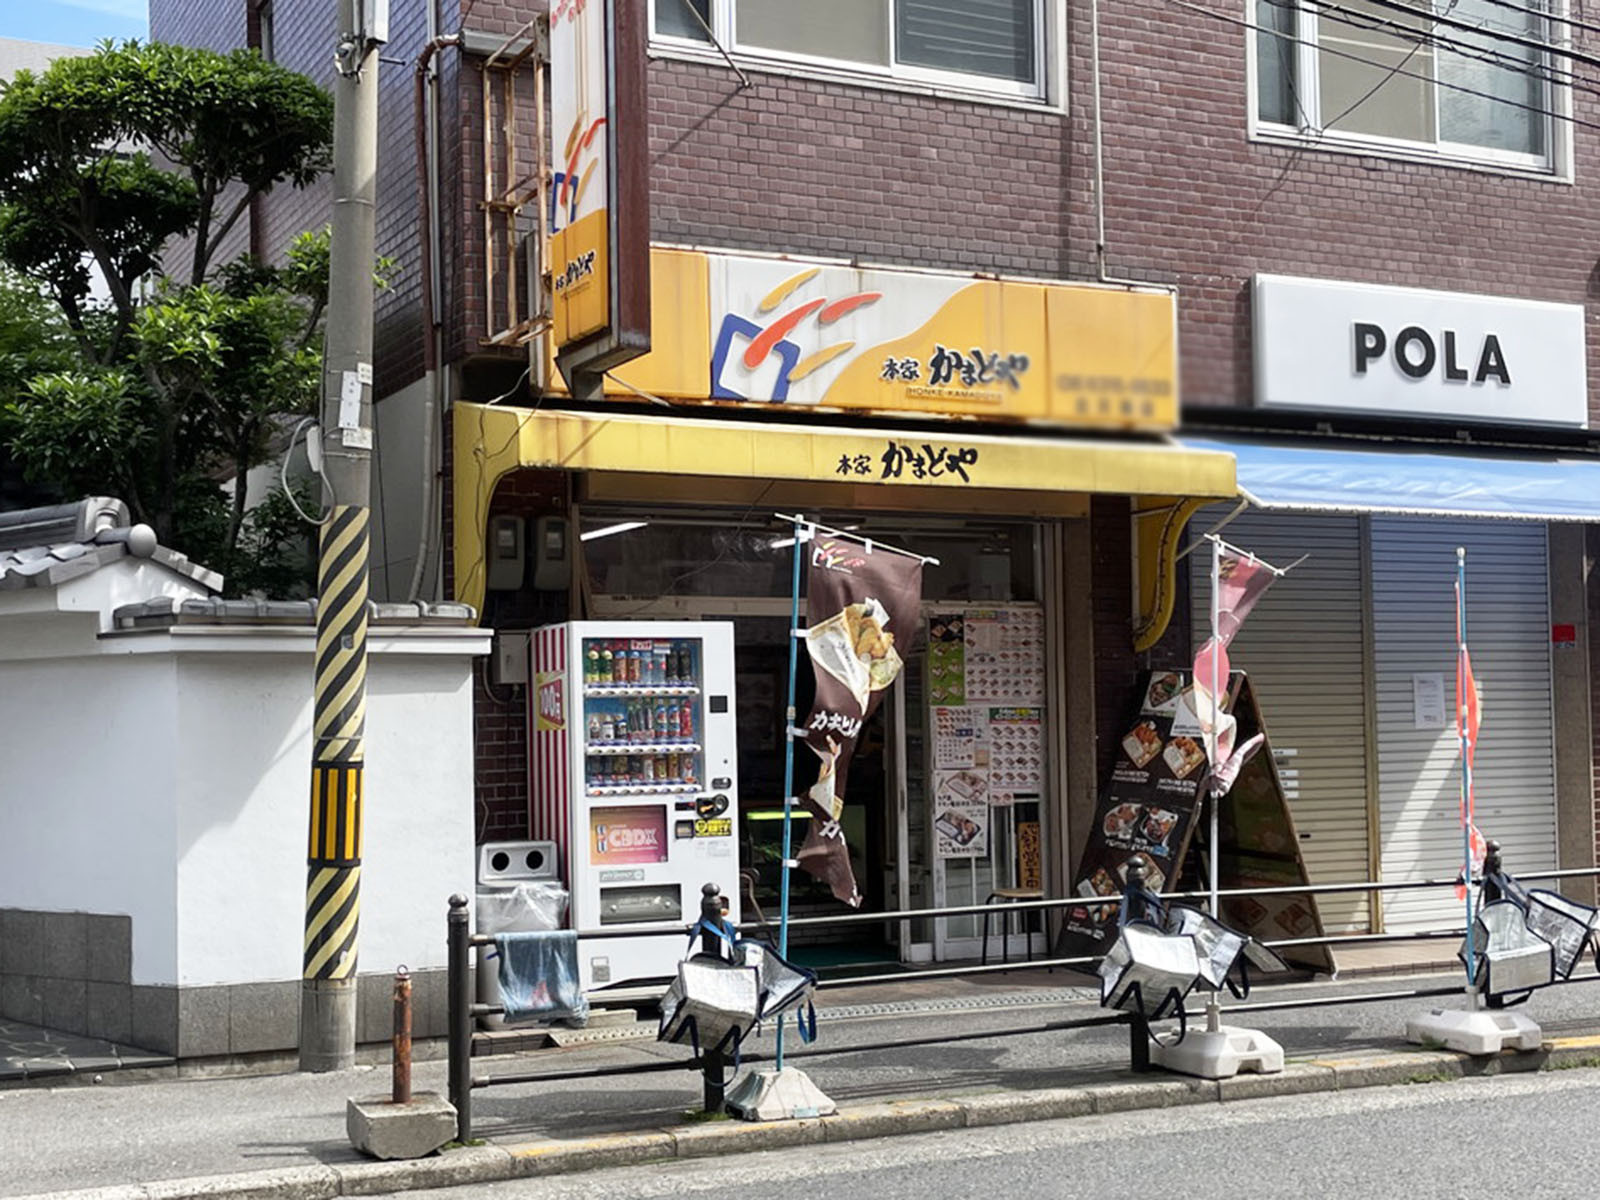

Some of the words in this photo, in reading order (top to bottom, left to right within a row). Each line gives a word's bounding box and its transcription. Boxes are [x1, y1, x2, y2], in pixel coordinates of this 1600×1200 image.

[882, 358, 920, 380] 本家
[1353, 322, 1512, 385] POLA
[836, 455, 872, 476] 本家
[881, 440, 979, 483] かまどや
